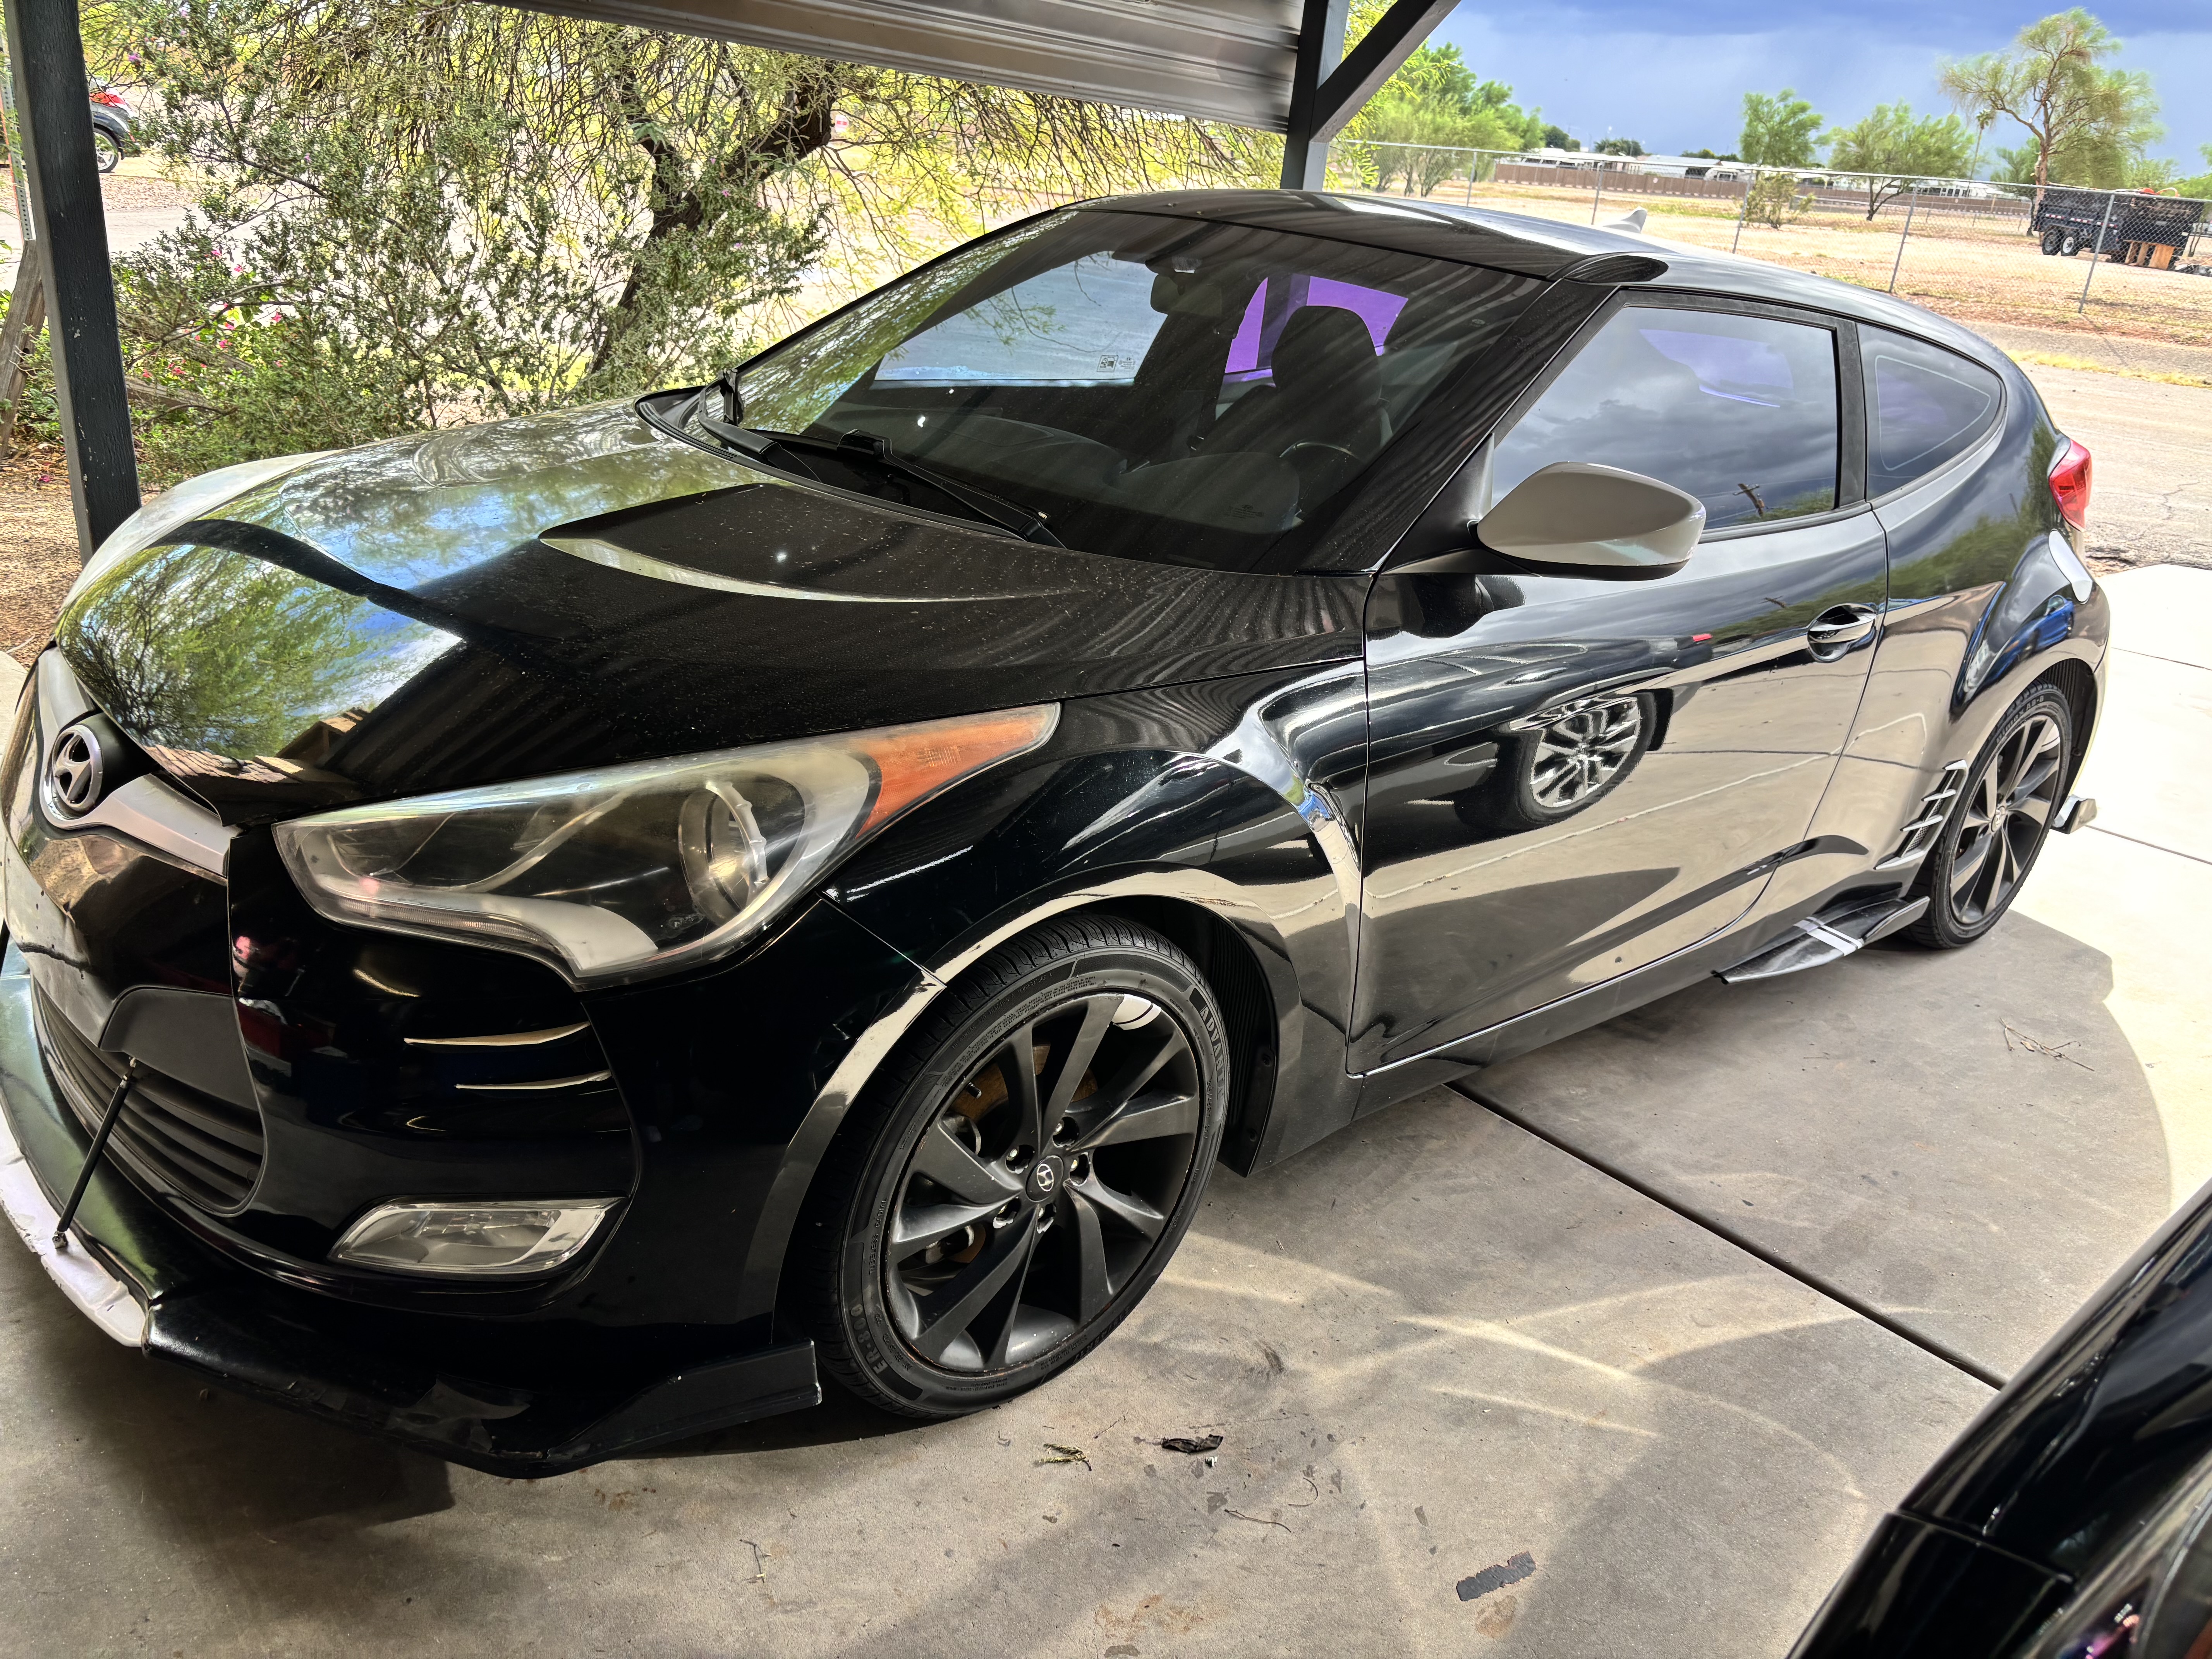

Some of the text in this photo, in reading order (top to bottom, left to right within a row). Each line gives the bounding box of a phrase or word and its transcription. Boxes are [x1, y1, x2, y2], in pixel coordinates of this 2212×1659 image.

[869, 1198, 888, 1275] TUBELESS RADIAL
[850, 1304, 888, 1374] ER-800
